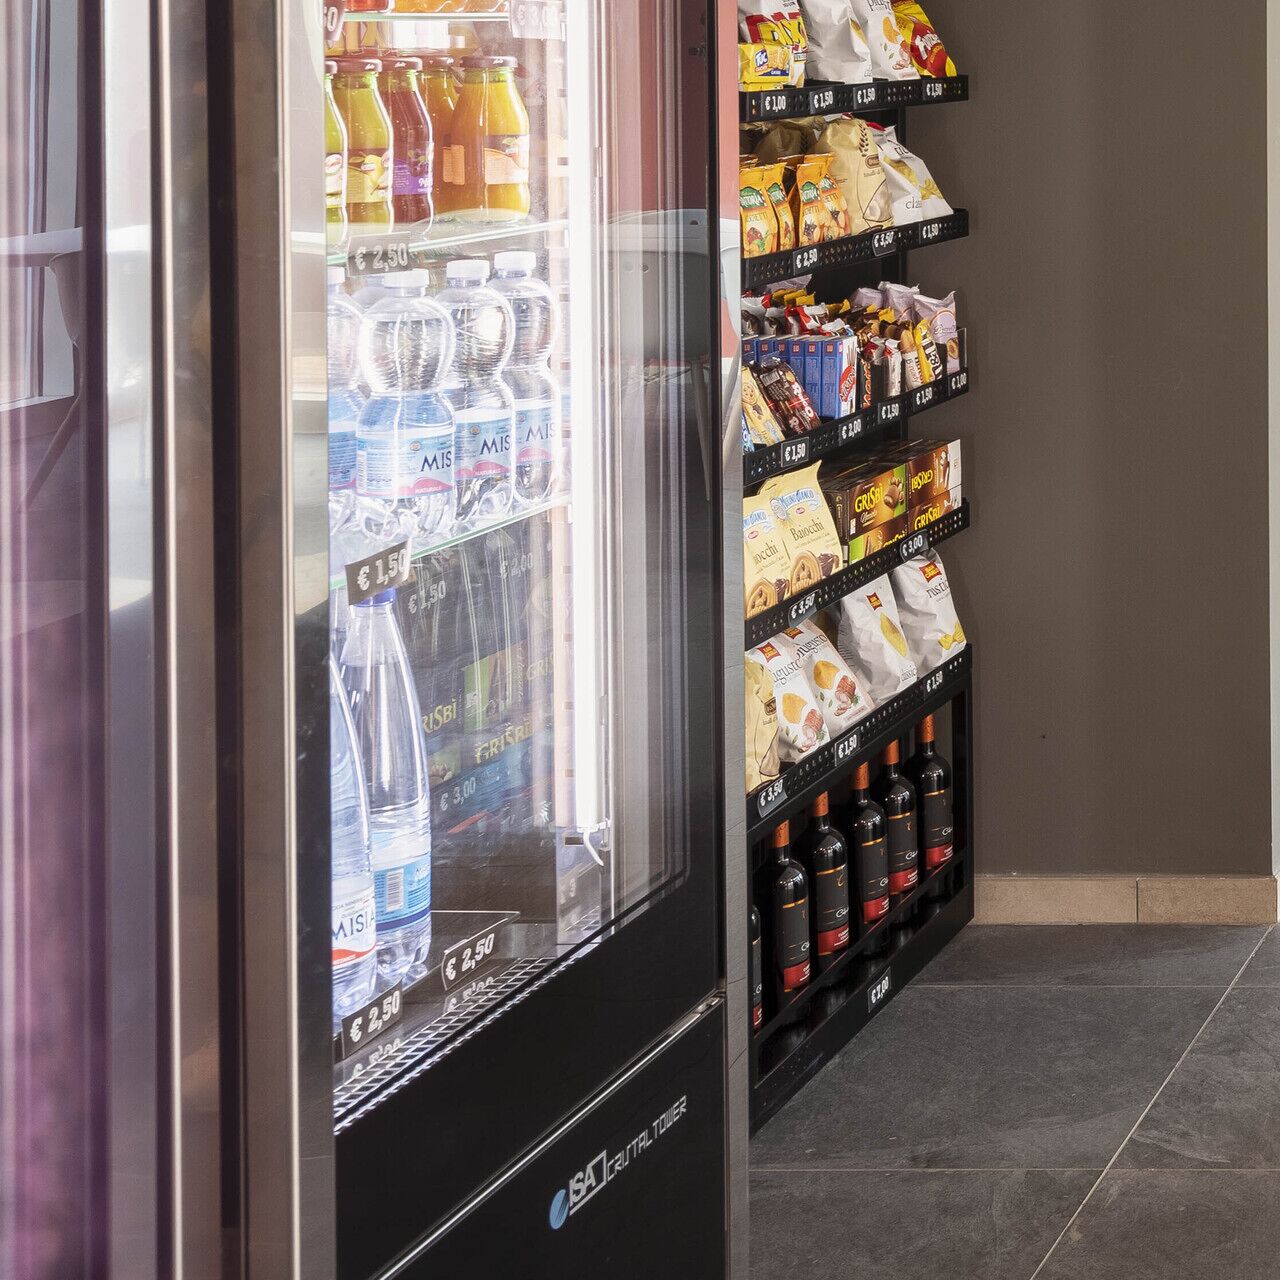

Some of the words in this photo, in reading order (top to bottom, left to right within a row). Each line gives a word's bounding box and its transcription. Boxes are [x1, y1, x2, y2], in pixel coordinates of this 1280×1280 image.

[819, 90, 834, 109] 1,50
[863, 87, 876, 104] 1,50
[931, 83, 943, 98] 1,50
[772, 95, 787, 112] 1,00
[880, 231, 894, 248] 3,50
[927, 223, 939, 239] 1,50
[372, 242, 408, 271] 2,50
[803, 248, 818, 267] 2,50
[921, 387, 933, 405] 1,50
[887, 403, 900, 420] 1,50
[848, 419, 862, 438] 2,00
[791, 443, 806, 463] 1,50
[790, 517, 825, 541] Baiocchi
[909, 534, 923, 554] 3,00
[375, 548, 407, 585] 1,50
[420, 580, 447, 610] 1,50
[797, 592, 816, 615] 3,50
[453, 776, 476, 805] 3,00
[767, 779, 783, 802] 3,50
[445, 956, 457, 981] €
[461, 933, 495, 972] 2,50
[350, 1016, 363, 1043] €
[368, 990, 400, 1033] 2,50
[607, 1128, 653, 1182] CRISTAL
[652, 1094, 687, 1139] TOWER
